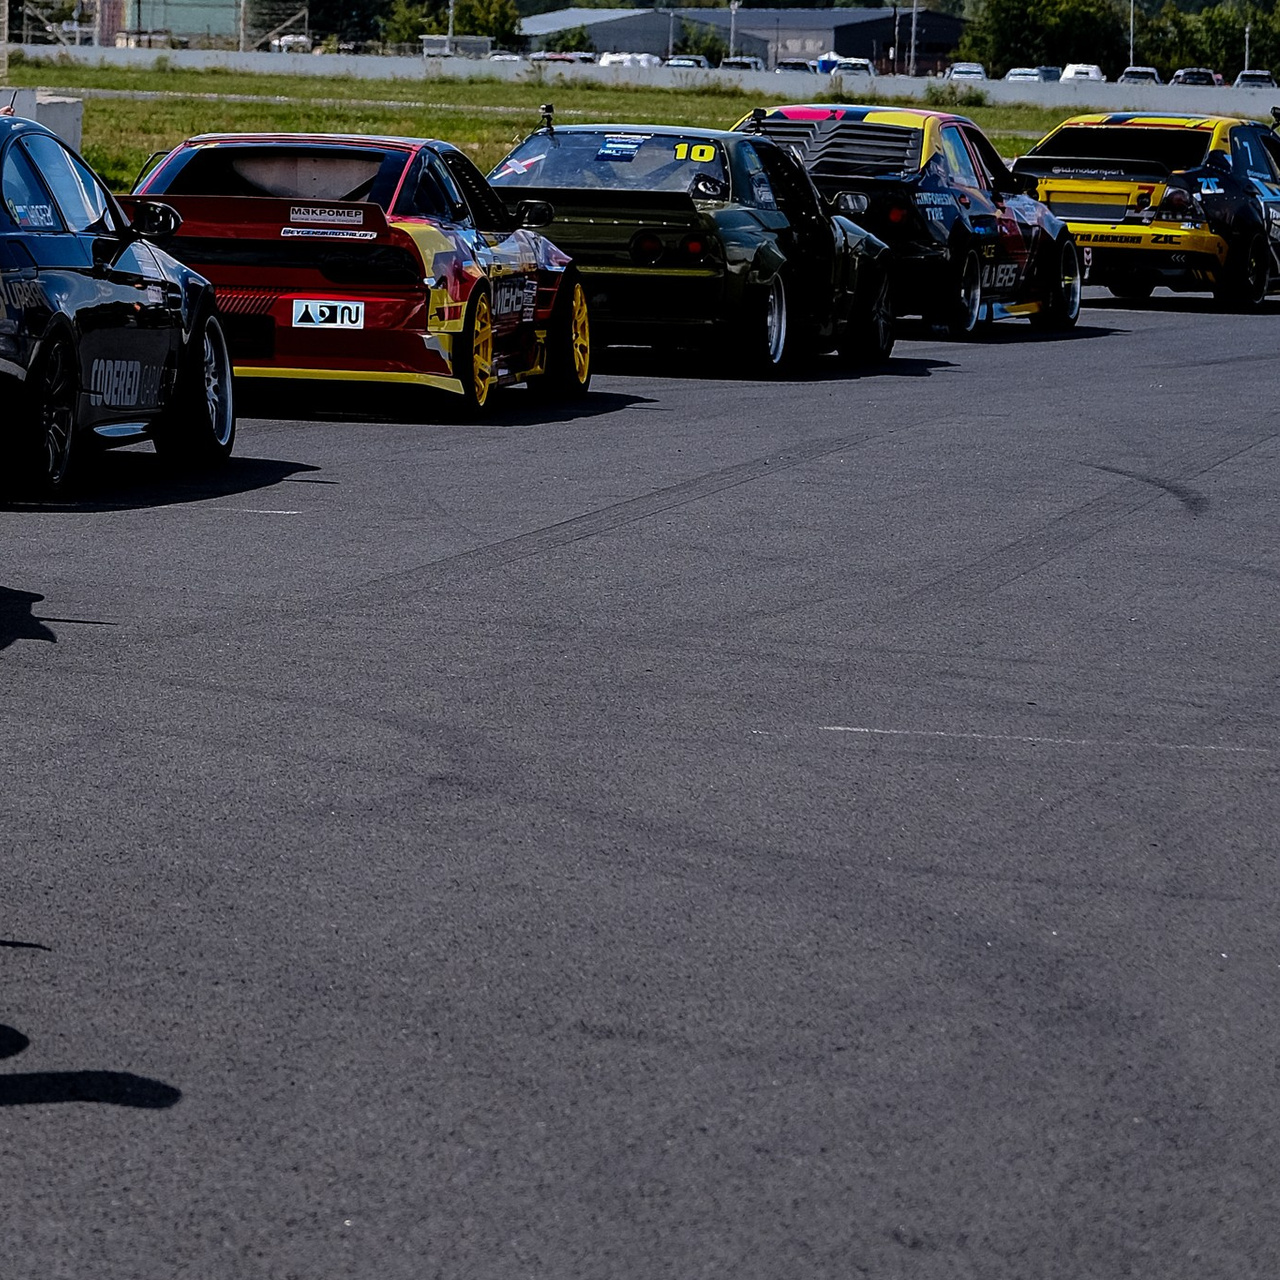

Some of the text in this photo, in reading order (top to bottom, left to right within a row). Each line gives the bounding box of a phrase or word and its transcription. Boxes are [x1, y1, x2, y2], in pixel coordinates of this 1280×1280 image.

[674, 142, 716, 162] 10
[1151, 233, 1182, 245] ZIC
[90, 358, 141, 406] CODERED
